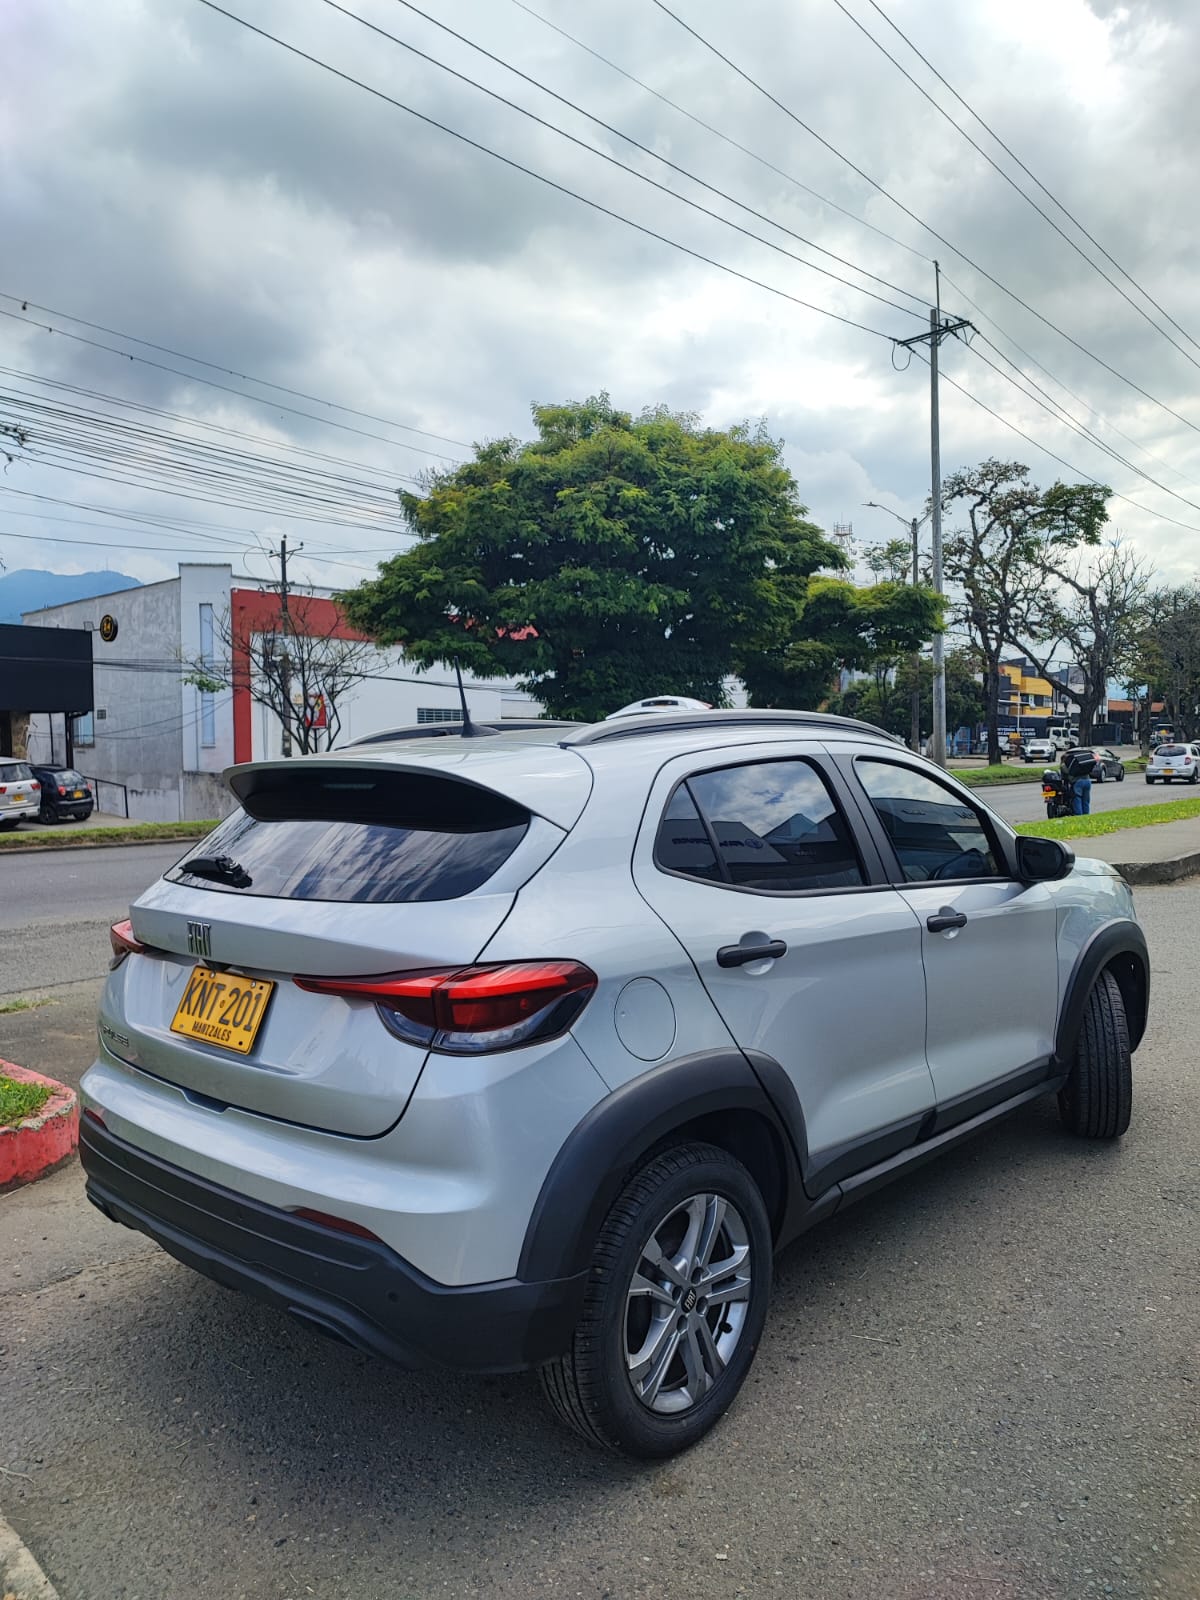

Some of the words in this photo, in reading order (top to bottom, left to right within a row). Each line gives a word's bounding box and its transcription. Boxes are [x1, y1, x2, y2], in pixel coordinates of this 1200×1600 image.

[187, 920, 211, 957] FIAT
[180, 977, 226, 1020] KNT
[218, 987, 262, 1032] 201
[191, 1020, 232, 1042] MANIZALES
[685, 1289, 696, 1310] FIAT
